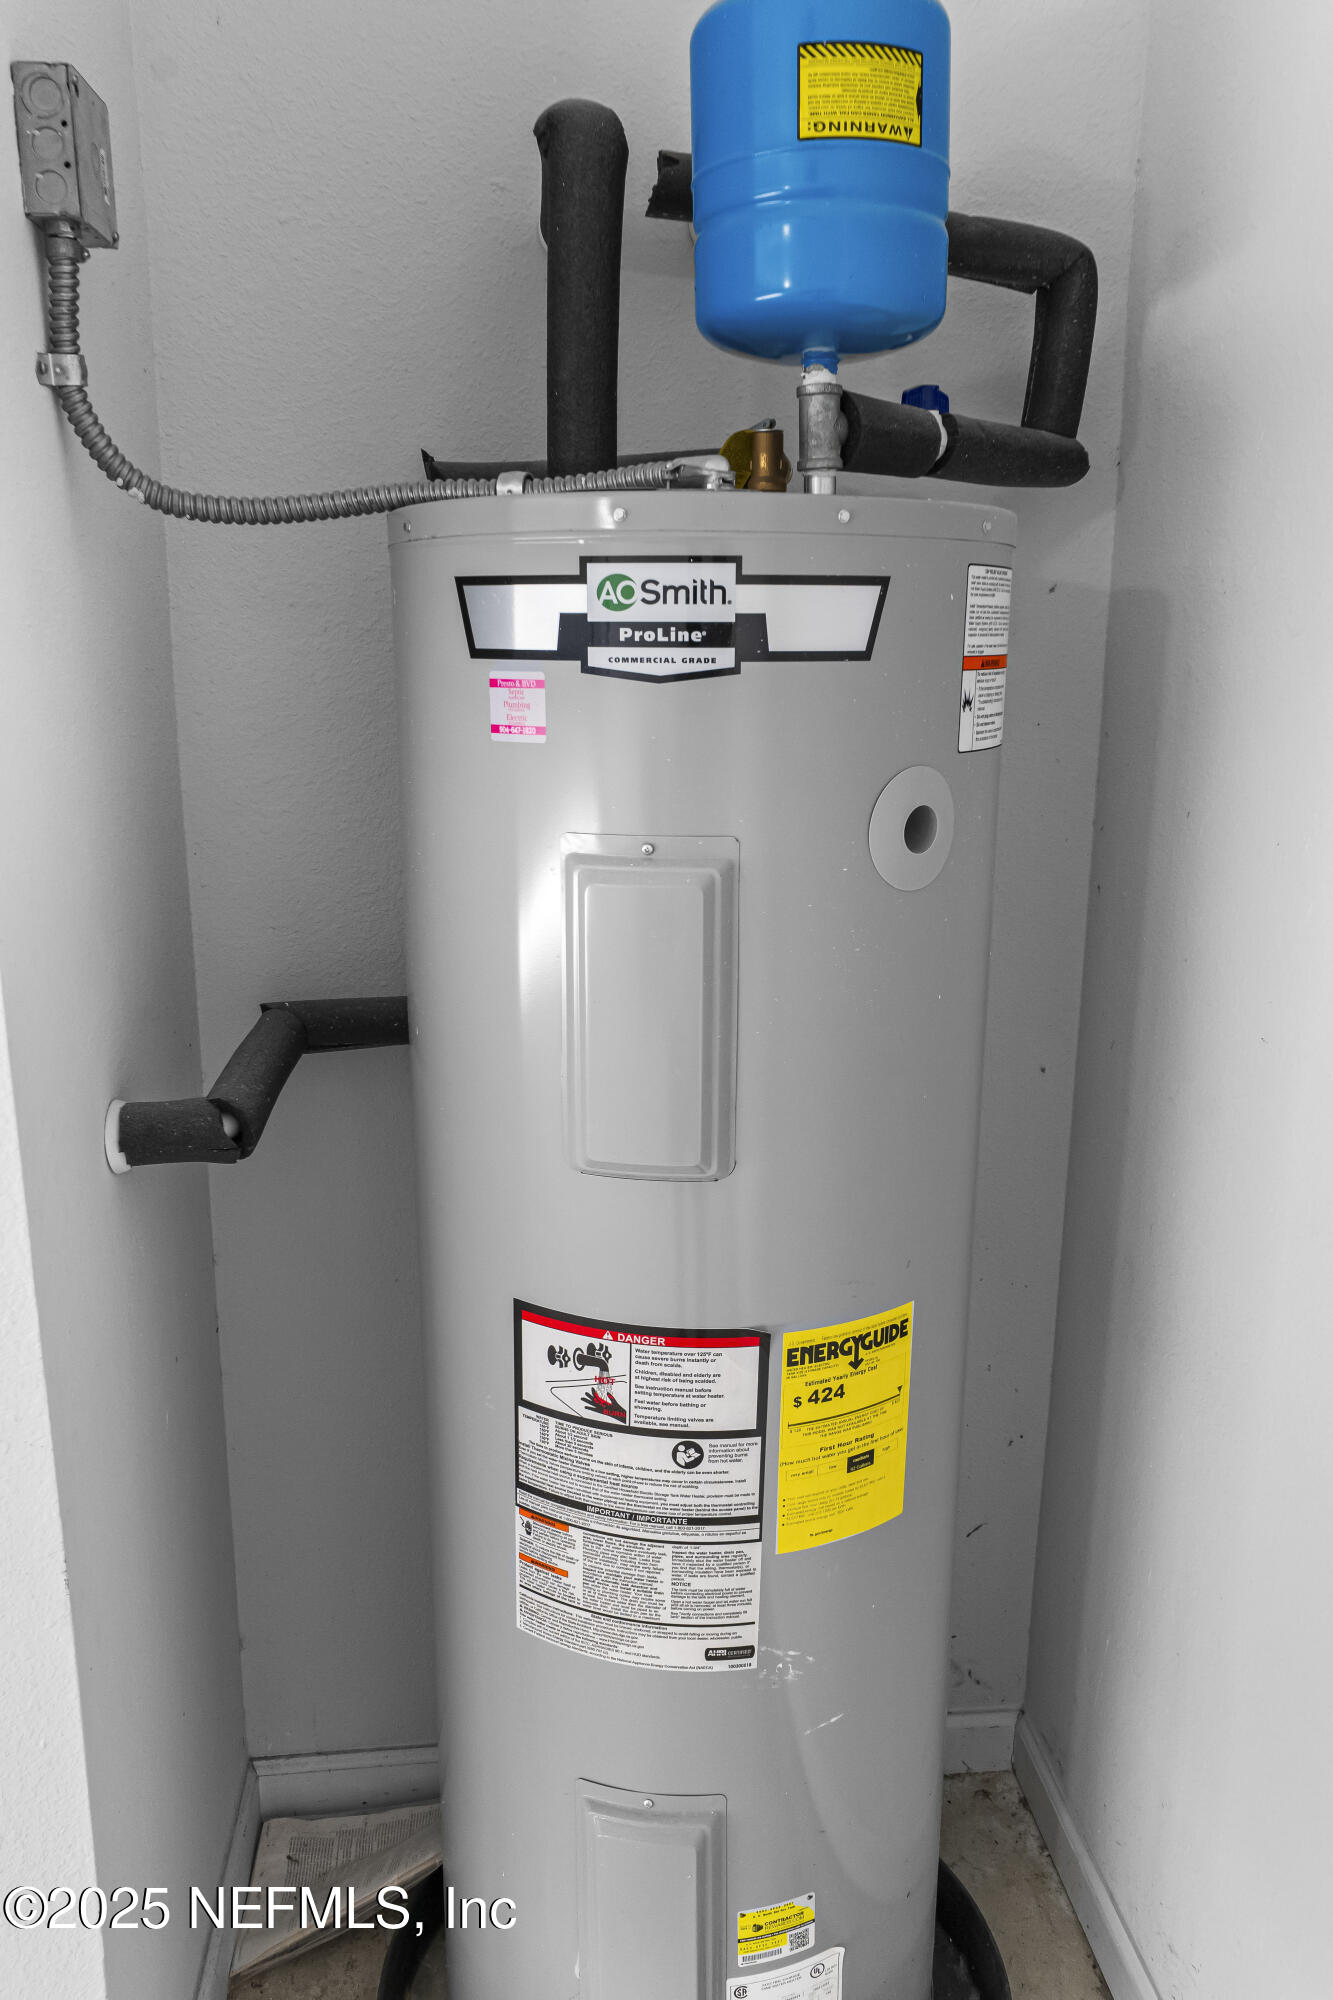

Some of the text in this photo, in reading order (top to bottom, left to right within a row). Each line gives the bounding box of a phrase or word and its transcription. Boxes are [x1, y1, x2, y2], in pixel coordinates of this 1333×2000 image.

[618, 1333, 666, 1346] DANGER
[787, 1318, 908, 1367] ENERGYGUIDE
[594, 1376, 615, 1386] HOT
[805, 1377, 831, 1387] Estimated
[850, 1368, 866, 1377] Energy
[793, 1384, 845, 1408] $ 424
[603, 1409, 626, 1418] BURN
[838, 1440, 853, 1448] Hour
[855, 1433, 874, 1443] Rating
[587, 1505, 630, 1519] IMPORTANT
[637, 1515, 687, 1524] IMPORTANTE
